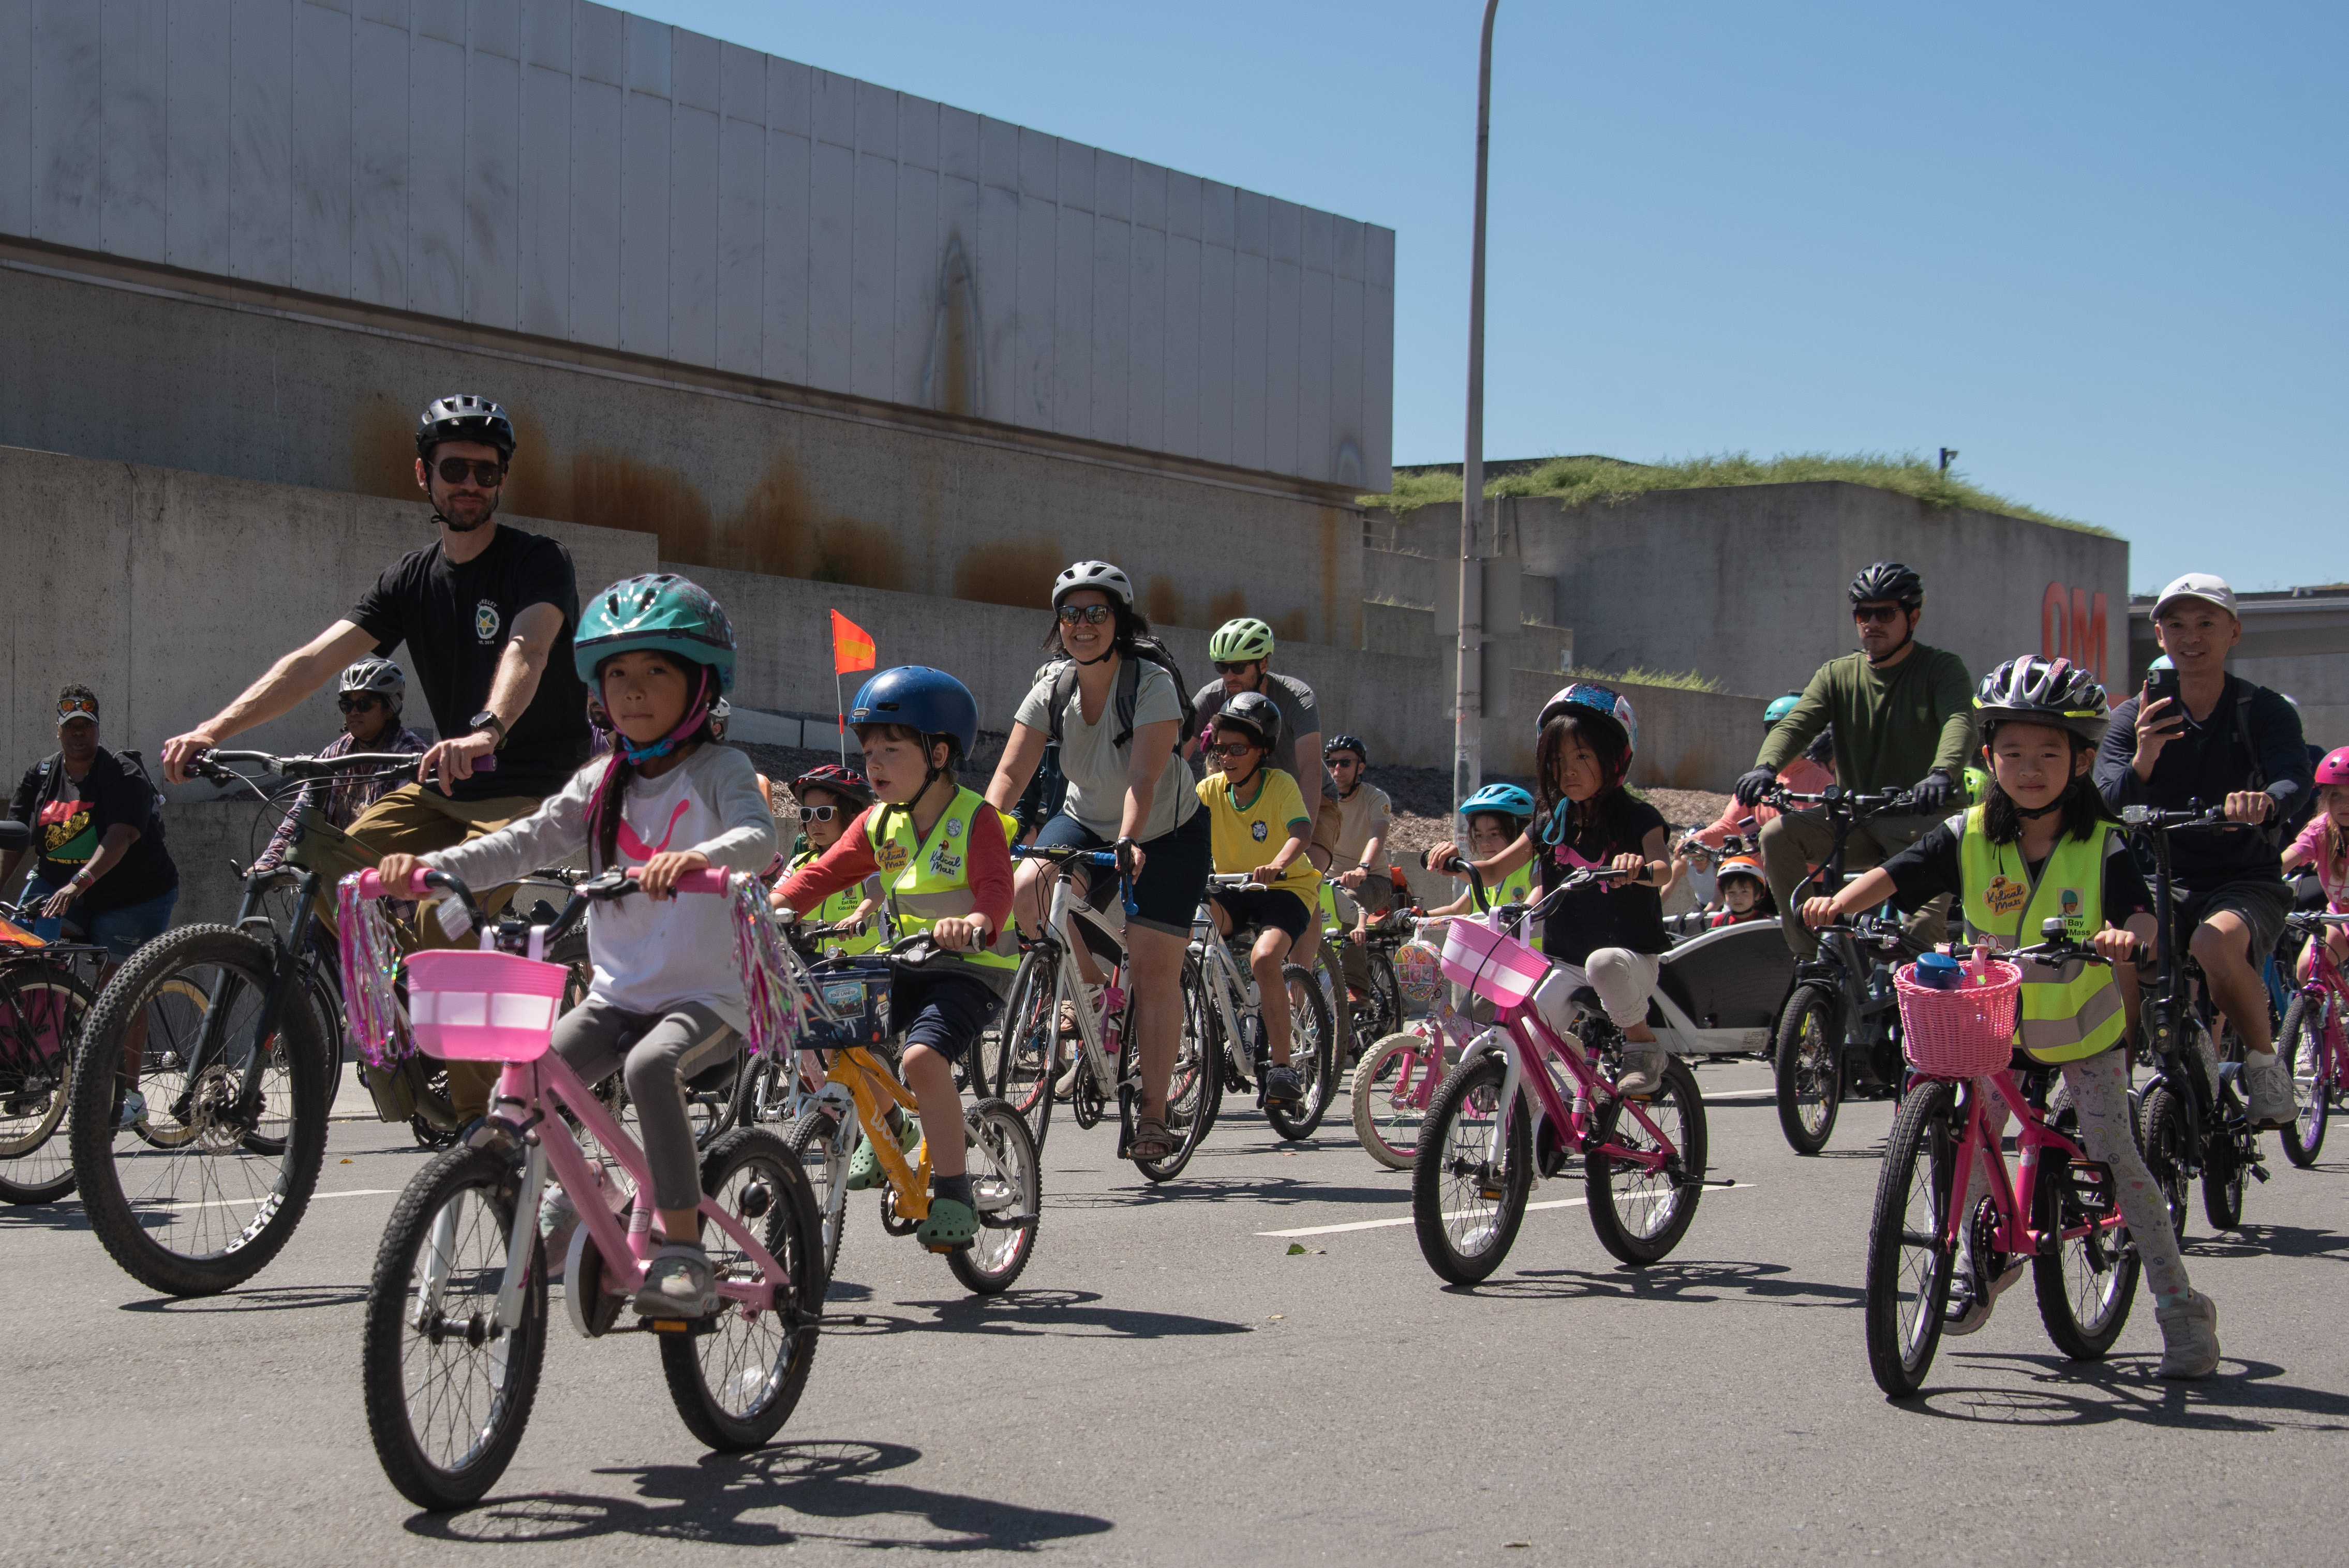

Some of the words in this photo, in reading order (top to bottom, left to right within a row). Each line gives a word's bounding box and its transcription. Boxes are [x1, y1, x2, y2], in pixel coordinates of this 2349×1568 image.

[2043, 581, 2107, 683] OM
[878, 848, 906, 863] Kidical
[930, 850, 961, 868] Kidical
[884, 860, 905, 870] Mass
[931, 861, 955, 875] Mass
[1986, 885, 2024, 904] Kidical
[1995, 899, 2021, 913] Mass
[2068, 919, 2084, 929] Bay
